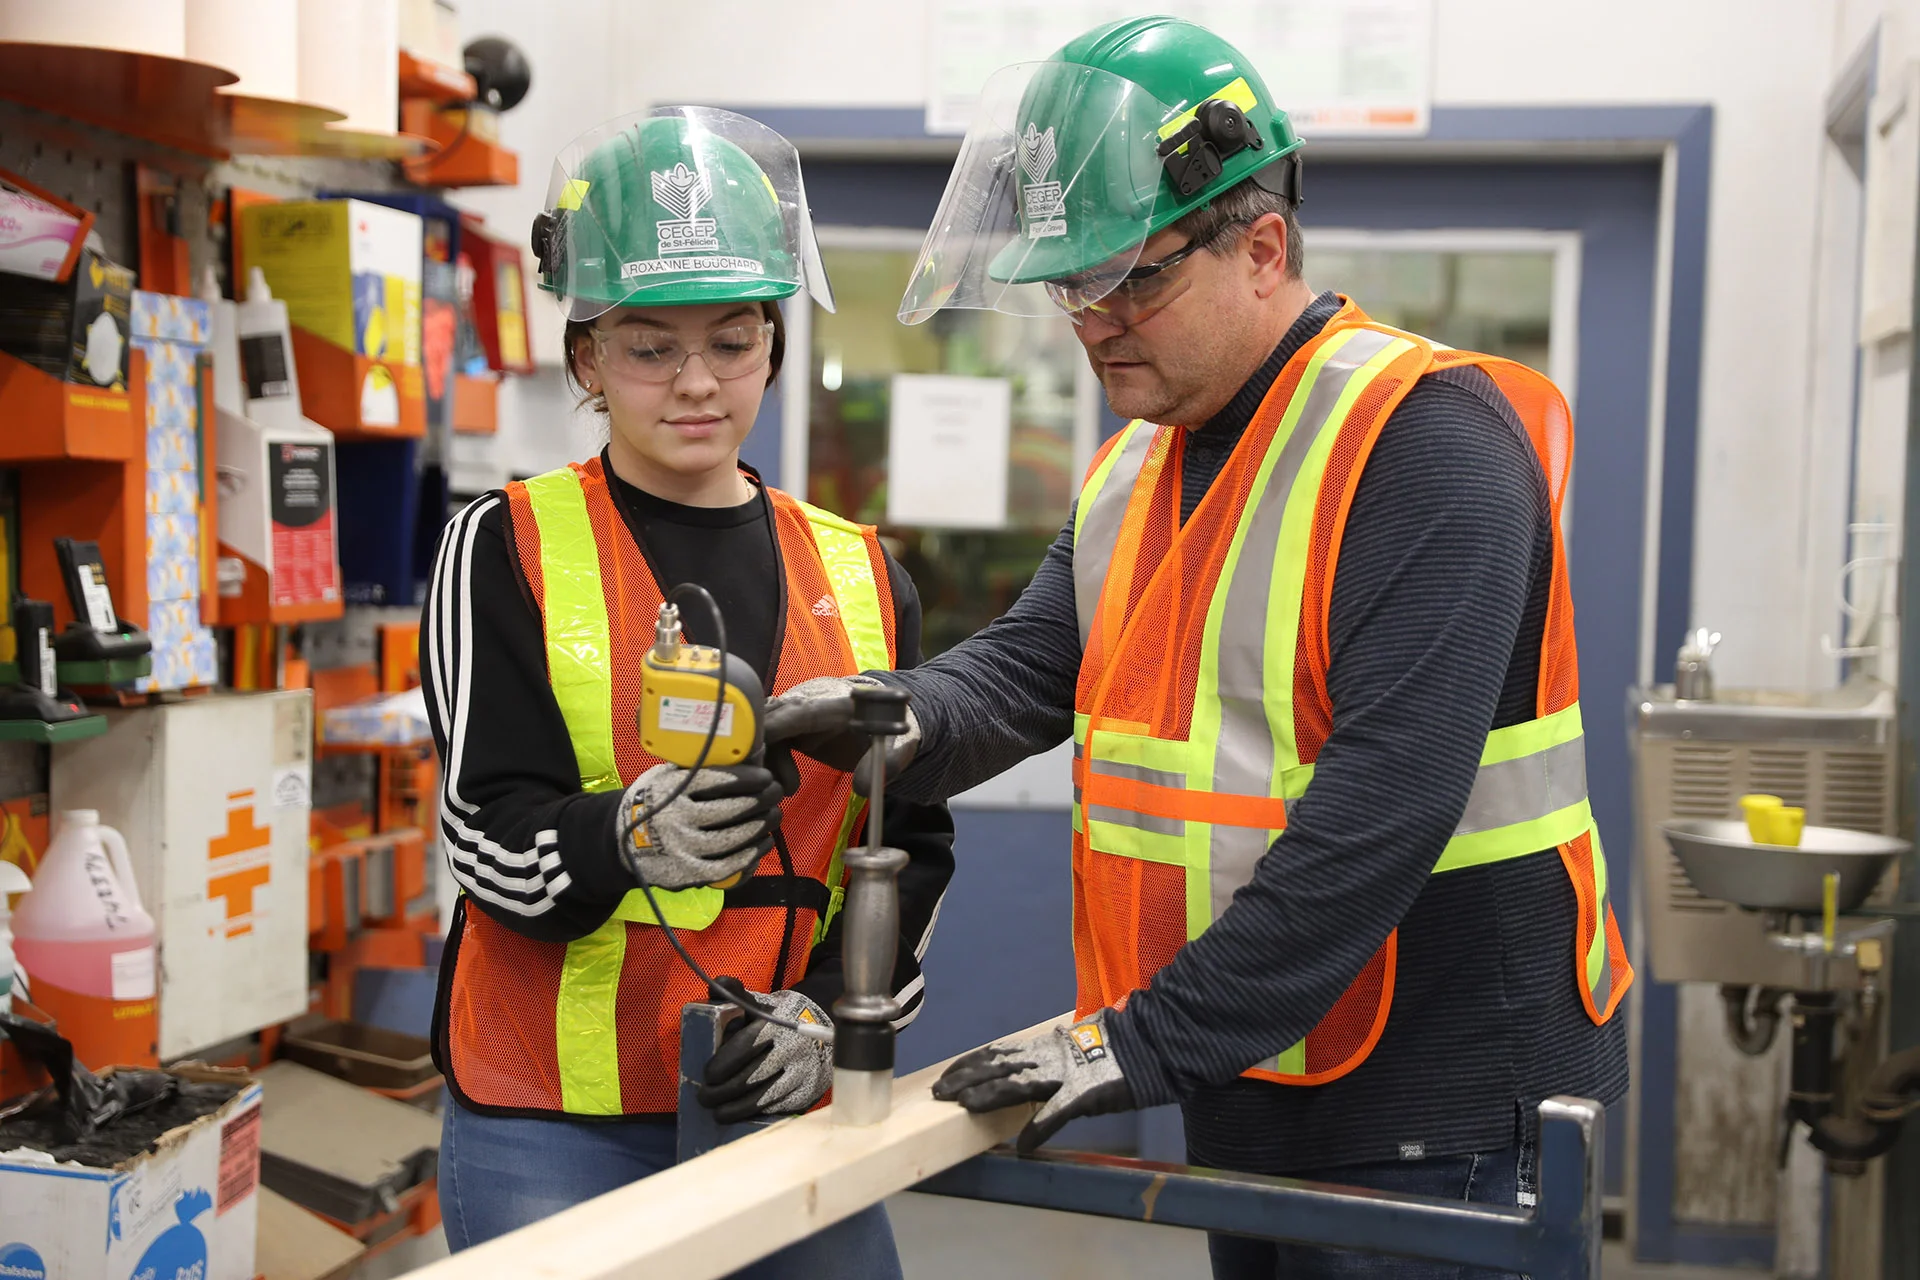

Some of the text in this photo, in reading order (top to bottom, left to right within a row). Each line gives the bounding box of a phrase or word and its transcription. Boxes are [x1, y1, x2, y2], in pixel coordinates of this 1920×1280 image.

[1025, 188, 1061, 205] CEGEP
[659, 225, 715, 240] CEGEP
[660, 238, 717, 249] de St-Félicien
[630, 257, 758, 275] ROXANNE BOUCHARD
